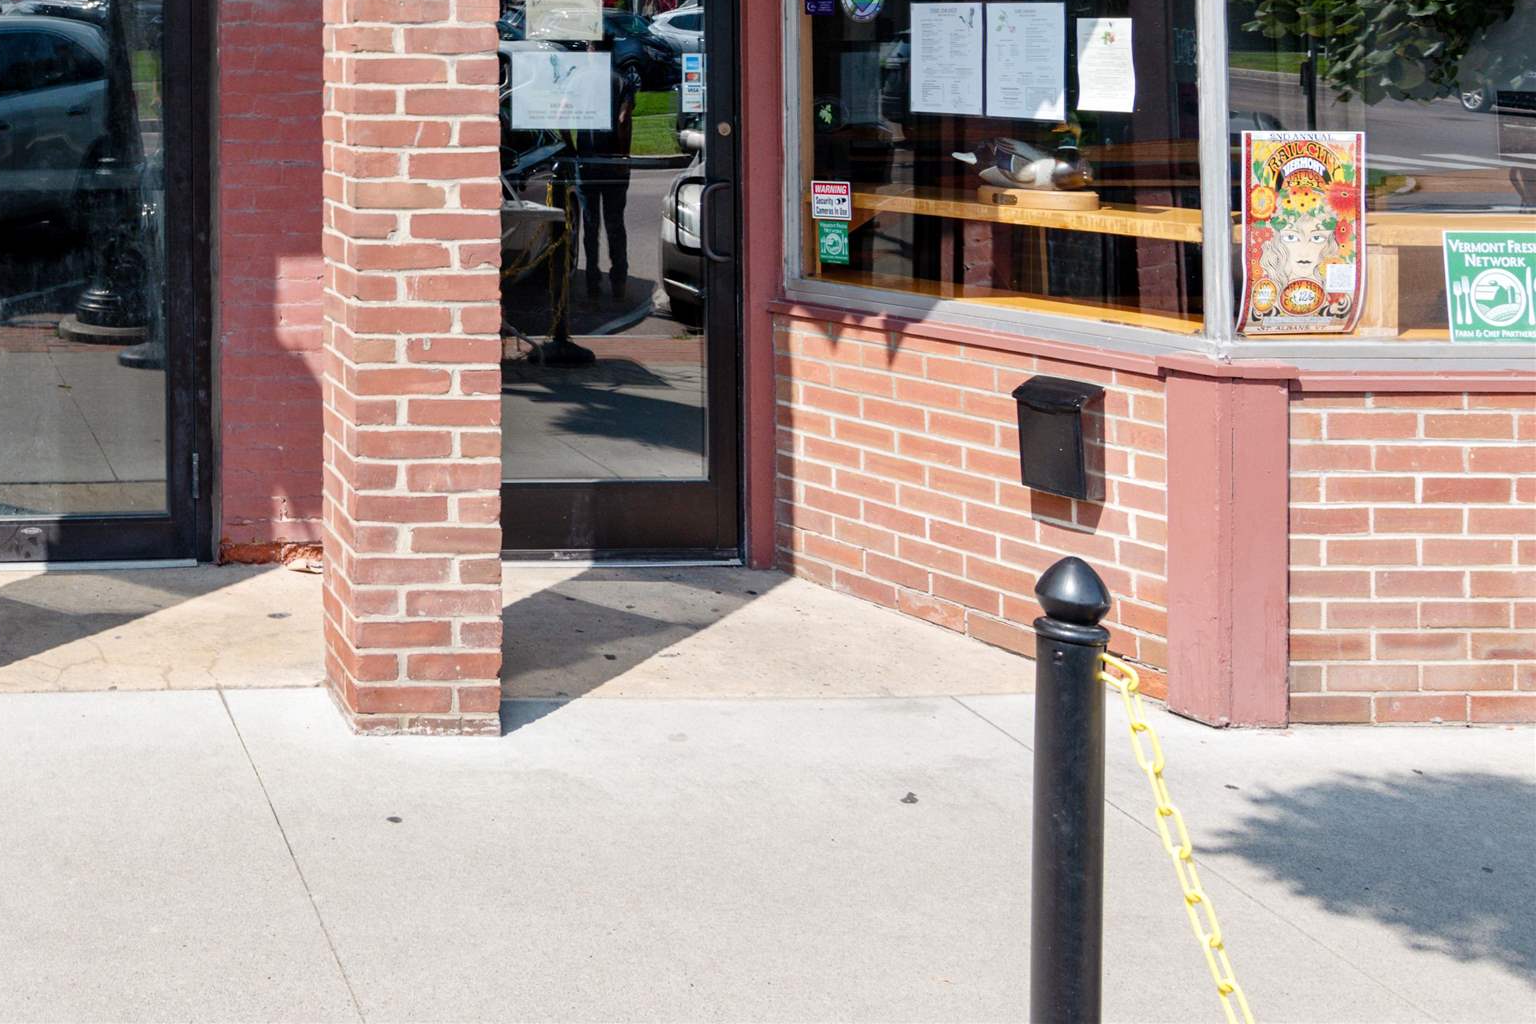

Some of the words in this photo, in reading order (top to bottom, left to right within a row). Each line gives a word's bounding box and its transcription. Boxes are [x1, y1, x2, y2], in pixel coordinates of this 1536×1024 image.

[1292, 133, 1334, 141] ANNUAL
[1268, 142, 1304, 179] RAIL
[1306, 142, 1342, 178] CITY
[1282, 157, 1326, 177] VERMONT
[814, 184, 847, 194] WARNING
[816, 196, 833, 206] Security
[1448, 239, 1506, 253] VERMONT
[1465, 253, 1526, 267] NETWORK
[1455, 329, 1475, 338] FARM
